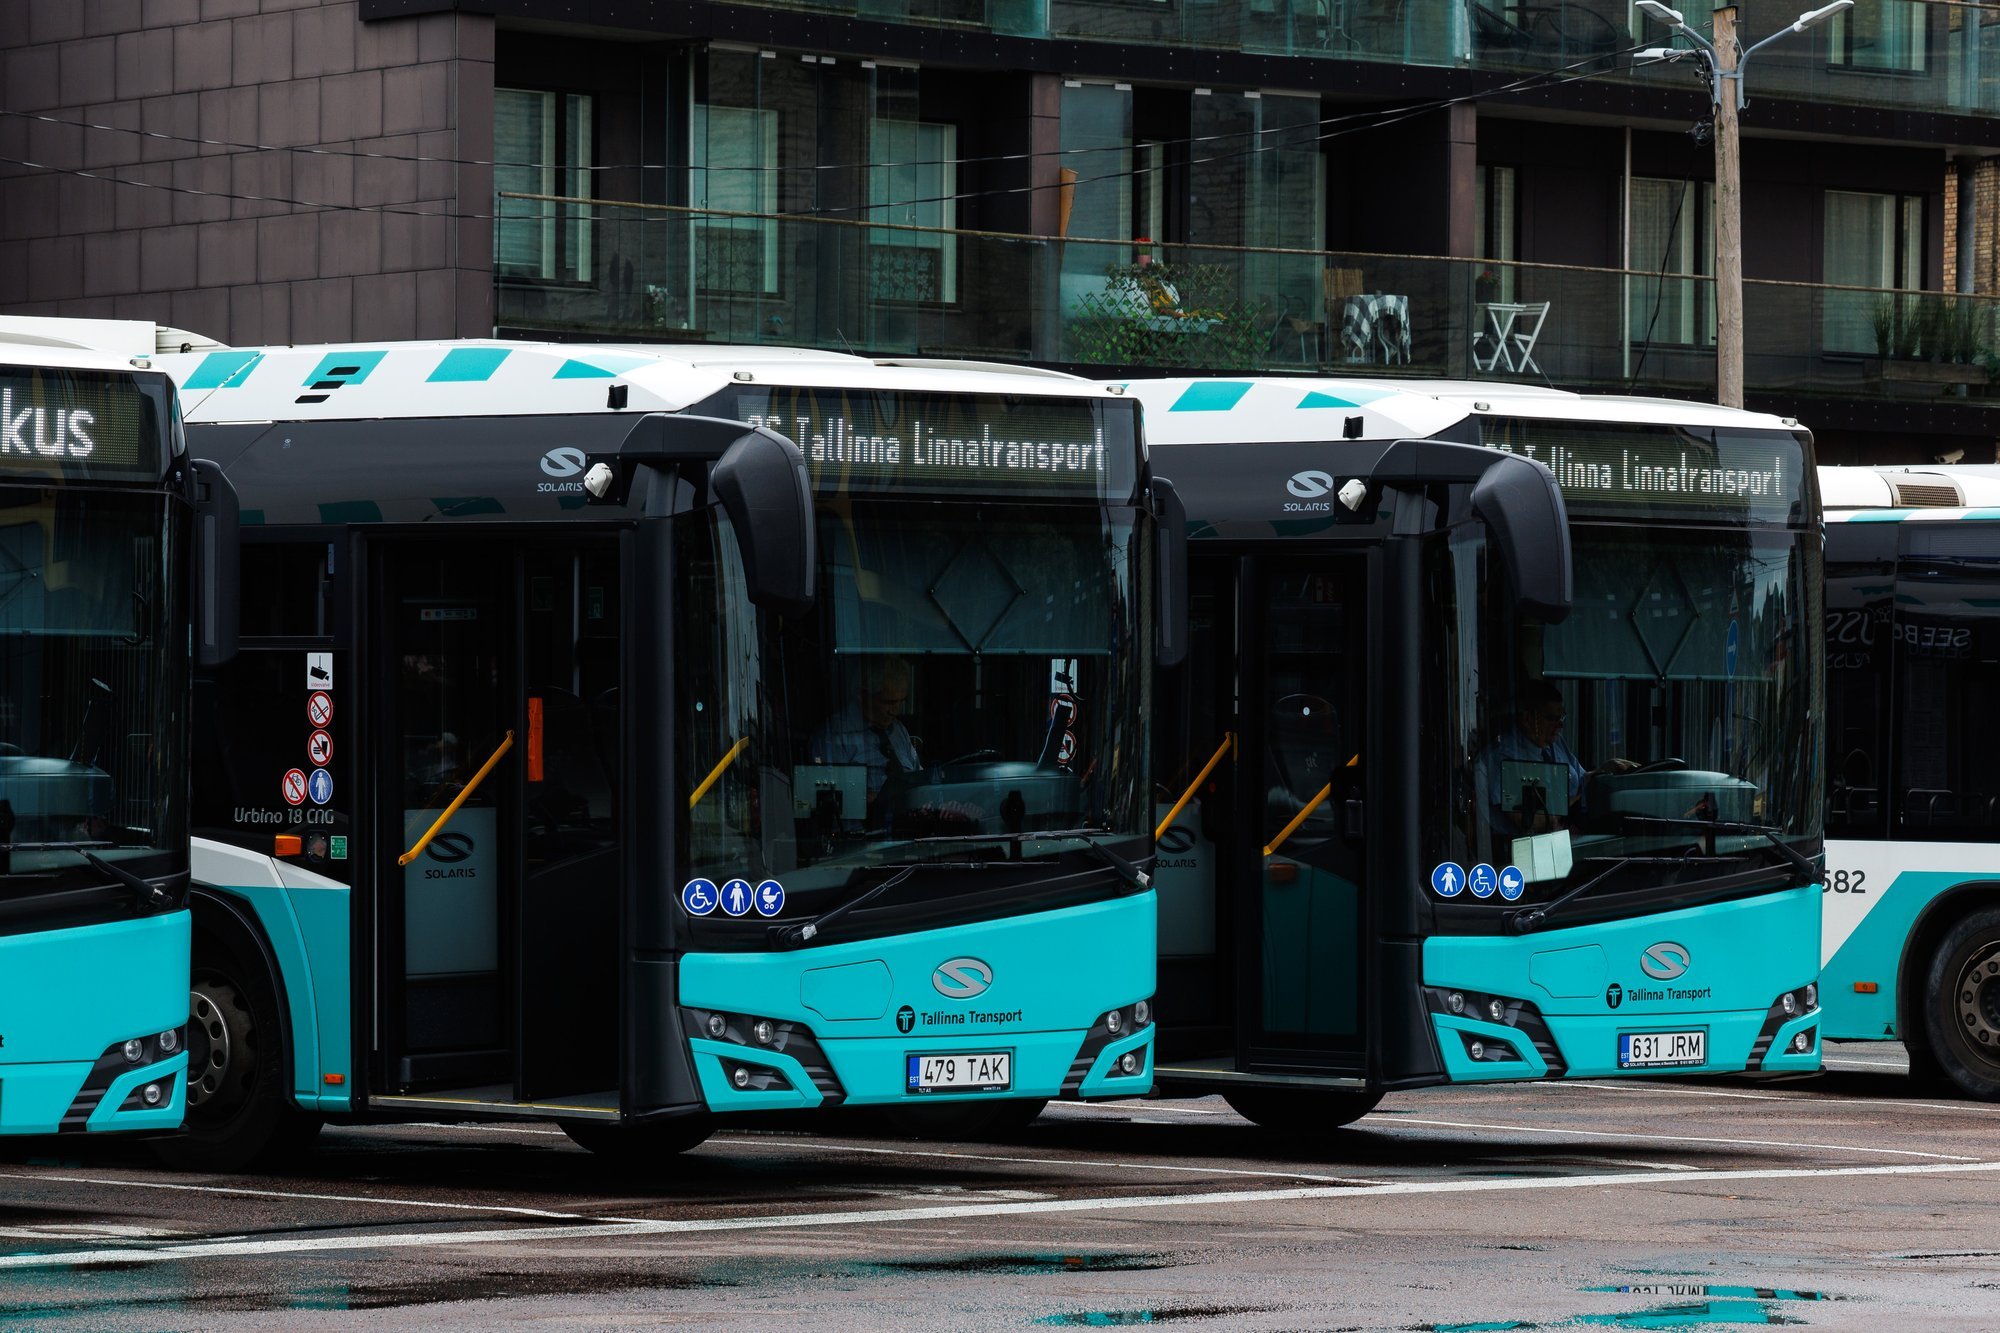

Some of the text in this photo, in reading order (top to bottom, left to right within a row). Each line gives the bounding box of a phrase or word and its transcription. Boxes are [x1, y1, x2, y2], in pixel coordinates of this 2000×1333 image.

[1, 388, 94, 457] kus
[797, 417, 1104, 471] Tallinna Linnatransport
[1623, 449, 1781, 496] Linnatransport
[537, 482, 583, 492] SOLARIS
[1283, 502, 1330, 512] SOLARIS
[234, 807, 283, 823] Urbino
[287, 808, 303, 824] 18
[1154, 859, 1197, 868] SOLARIS
[424, 868, 476, 879] SOLARIS
[1822, 869, 1866, 894] 582
[1627, 986, 1711, 1002] Tallinna Transport
[920, 1009, 1023, 1026] Tallinna Transport
[1633, 1037, 1659, 1059] 631
[1667, 1035, 1700, 1057] JRM
[924, 1059, 955, 1083] 479
[967, 1057, 1004, 1081] TAK
